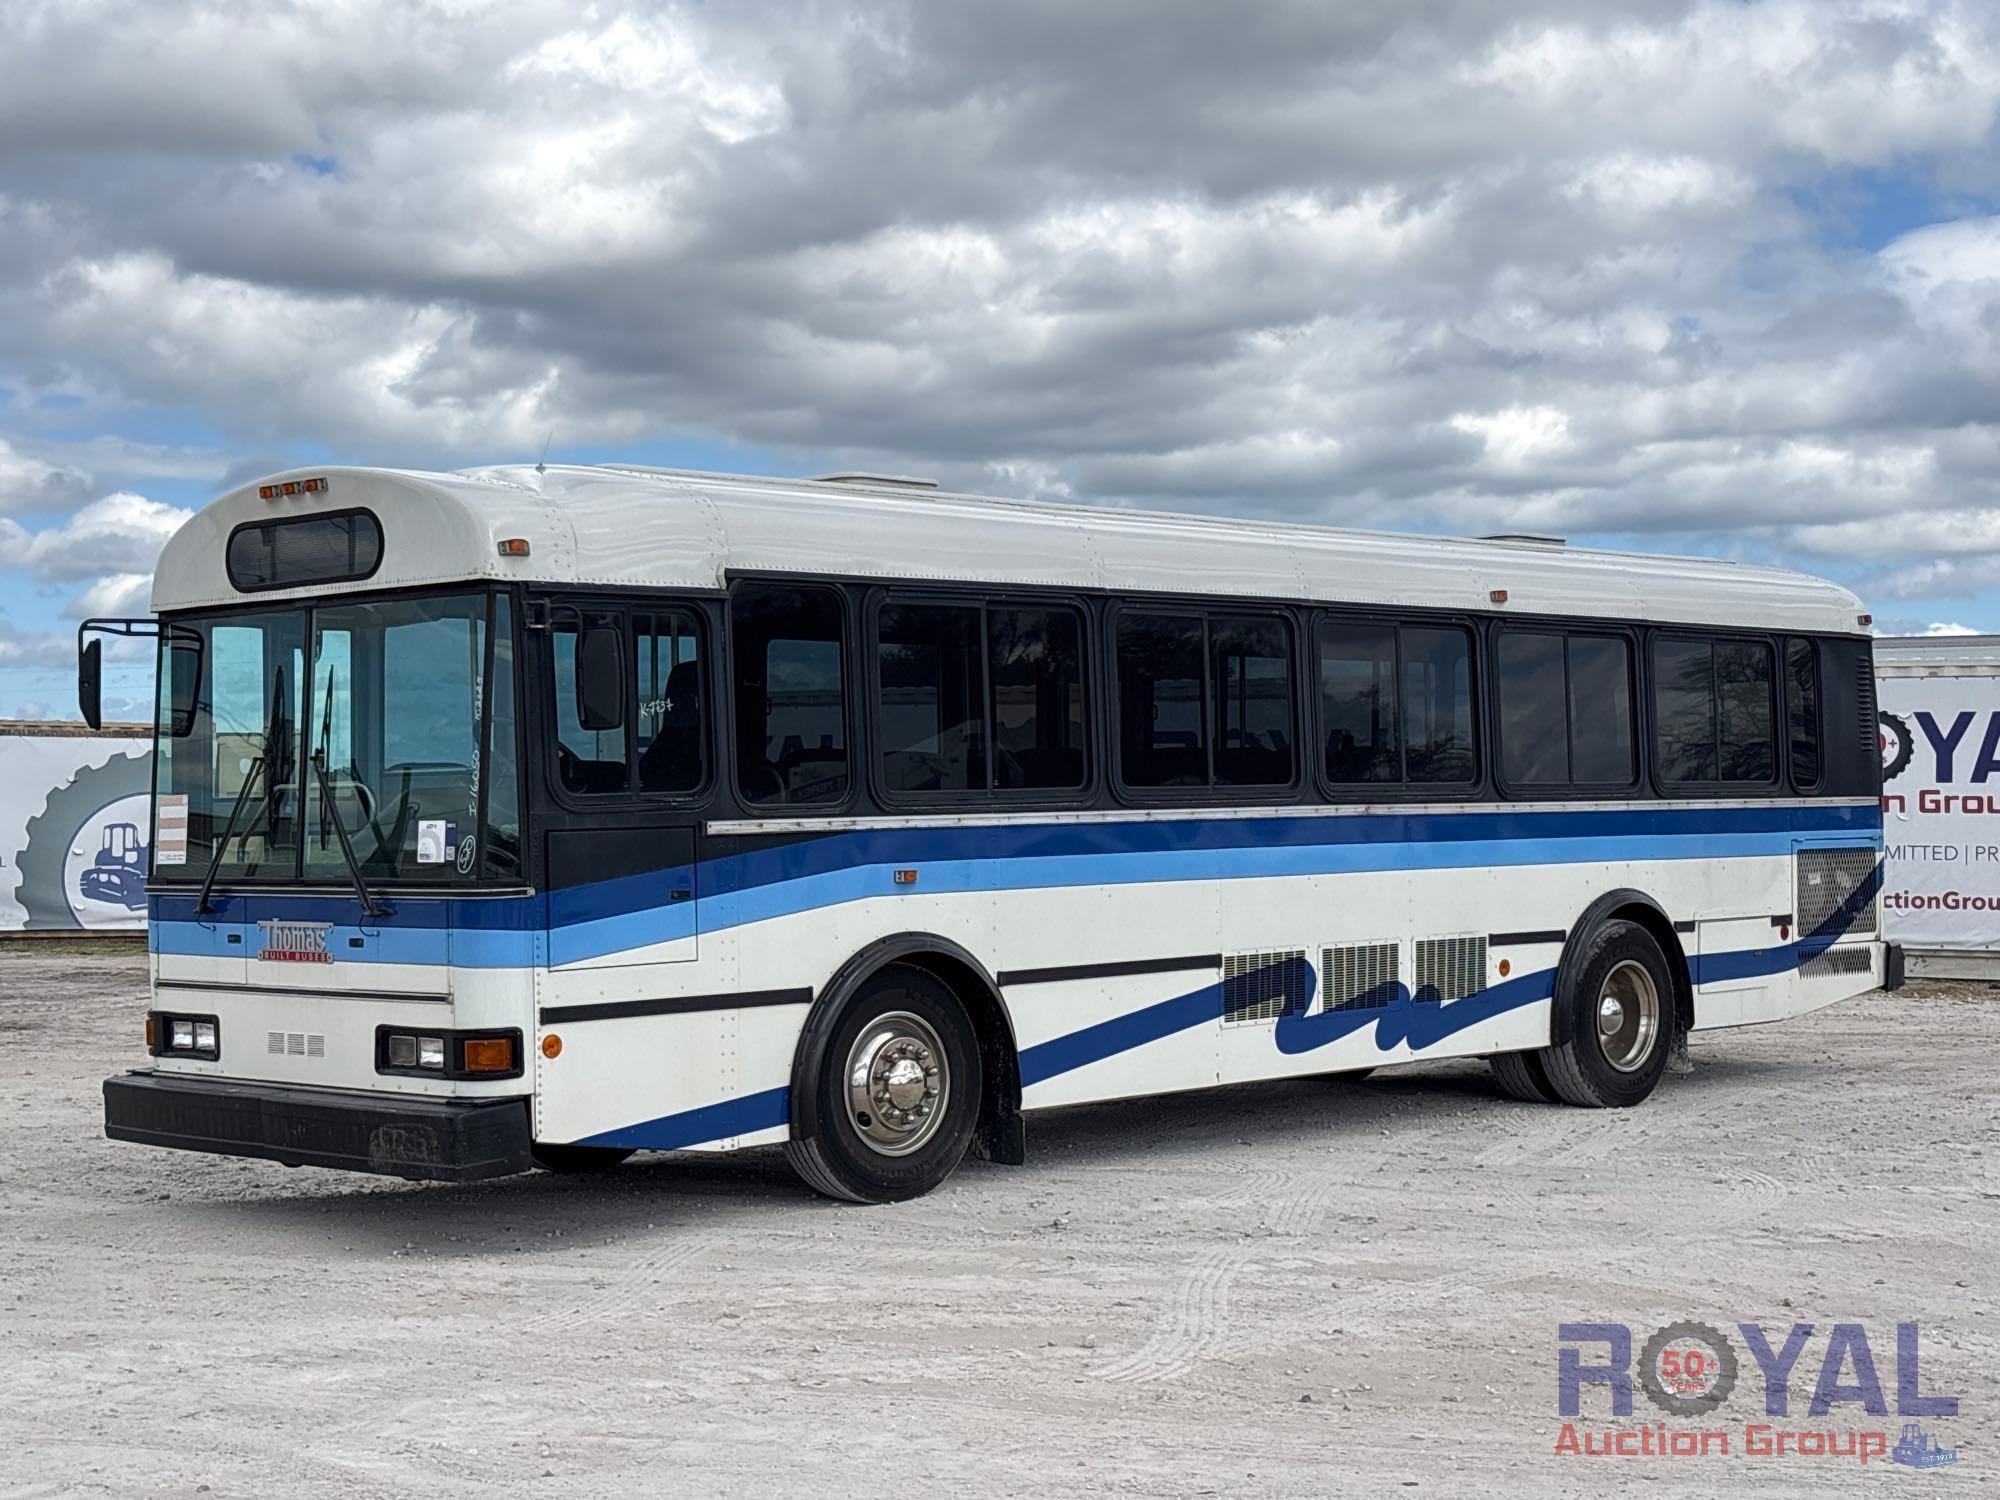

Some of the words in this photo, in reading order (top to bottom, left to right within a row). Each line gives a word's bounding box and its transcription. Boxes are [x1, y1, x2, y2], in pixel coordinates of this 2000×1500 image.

[1885, 845, 1958, 861] MITTED
[257, 918, 334, 952] Thomas
[264, 951, 290, 960] BUILT
[295, 952, 326, 961] BUSES
